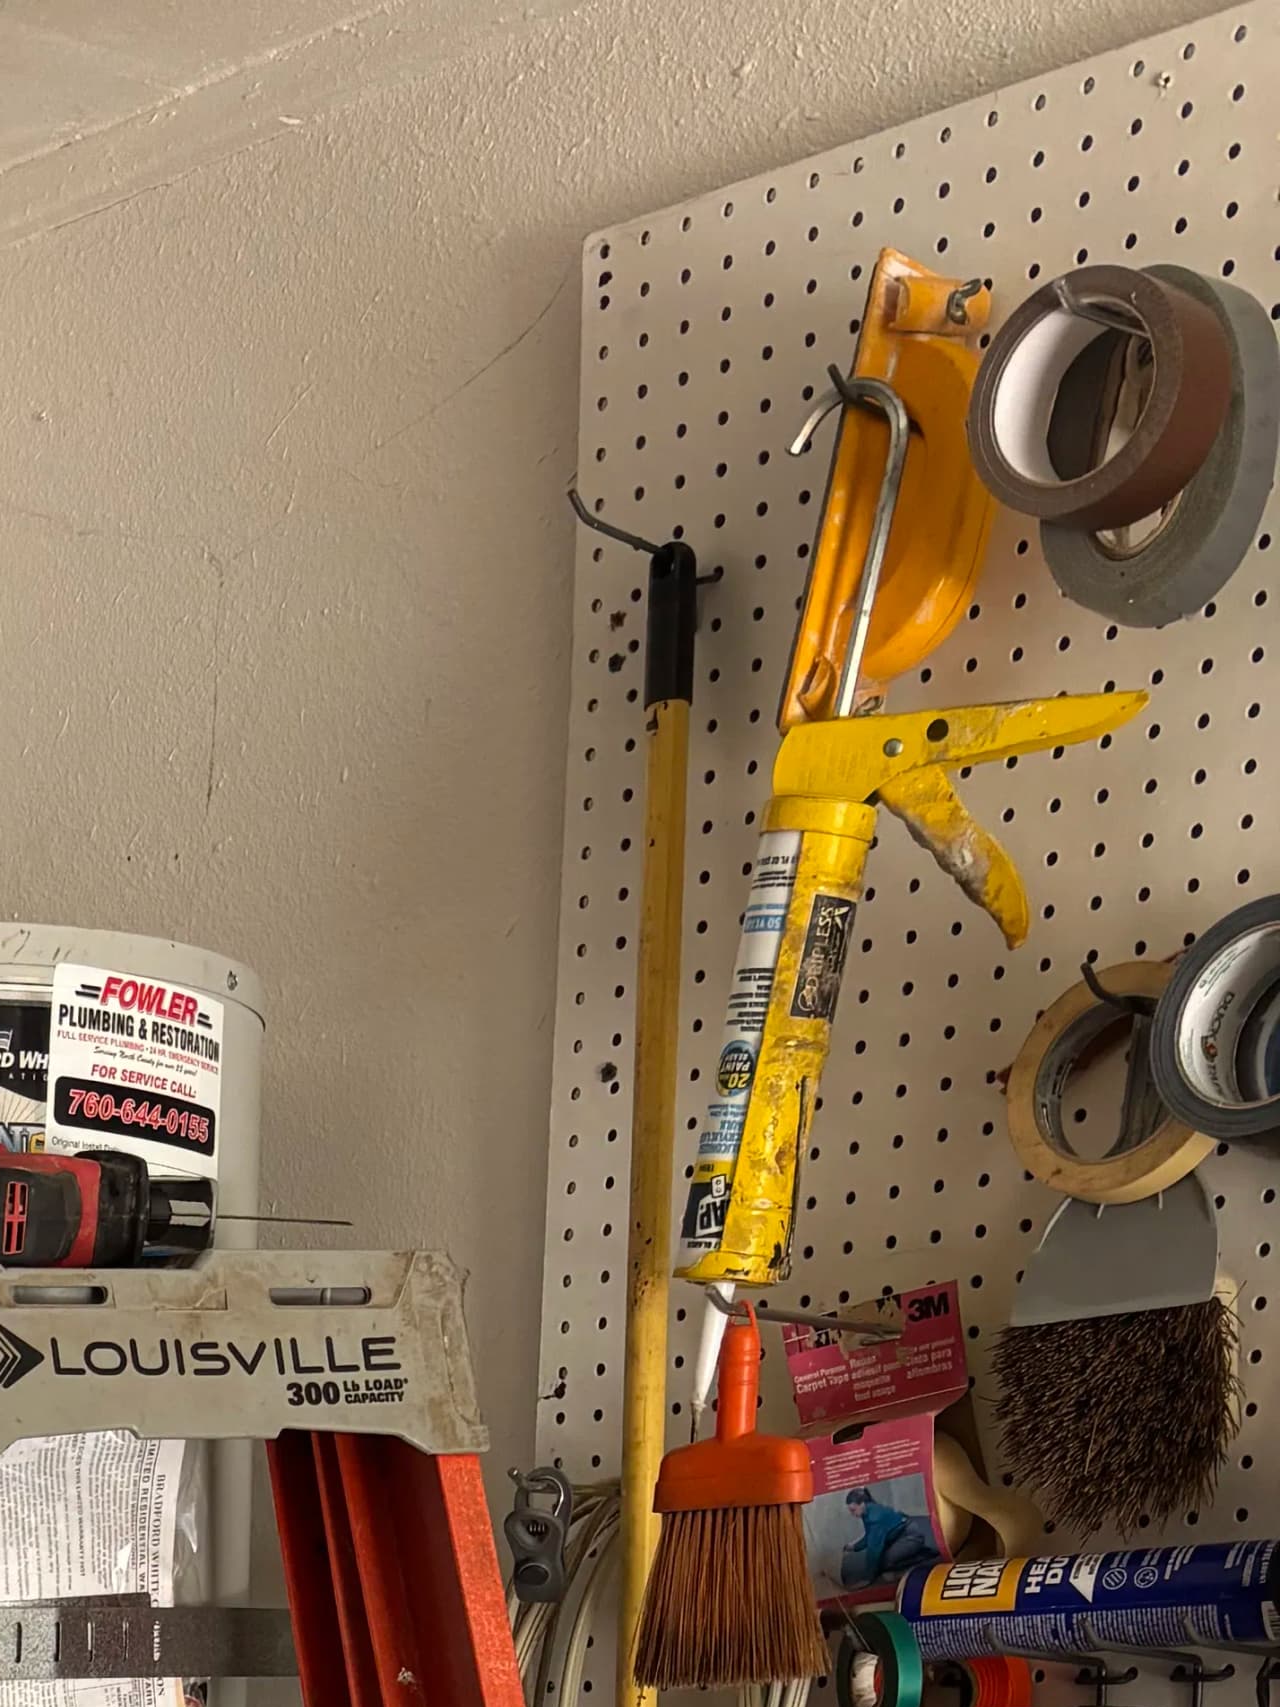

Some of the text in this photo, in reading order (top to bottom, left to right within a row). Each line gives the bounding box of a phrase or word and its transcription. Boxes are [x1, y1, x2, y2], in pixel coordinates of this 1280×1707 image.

[804, 904, 835, 989] DRIPLESS
[101, 976, 199, 1026] FOWLER
[57, 1030, 76, 1040] FULL
[79, 1033, 108, 1045] SERVICE
[58, 1004, 219, 1062] PLUMBING & RESTORATION
[91, 1064, 196, 1098] FOR SERVICE CALL:
[727, 1070, 749, 1089] 20
[68, 1088, 210, 1143] 760-644-0155
[52, 1136, 80, 1148] Original
[909, 1292, 949, 1322] 3M
[51, 1335, 401, 1377] LOUISVILLE
[286, 1379, 360, 1406] 300 Lb
[344, 1391, 404, 1404] CAPACITY
[796, 1380, 827, 1394] Carpet
[138, 1488, 149, 1566] RESIDENTIAL
[149, 1474, 165, 1595] BRADFORD WHITE
